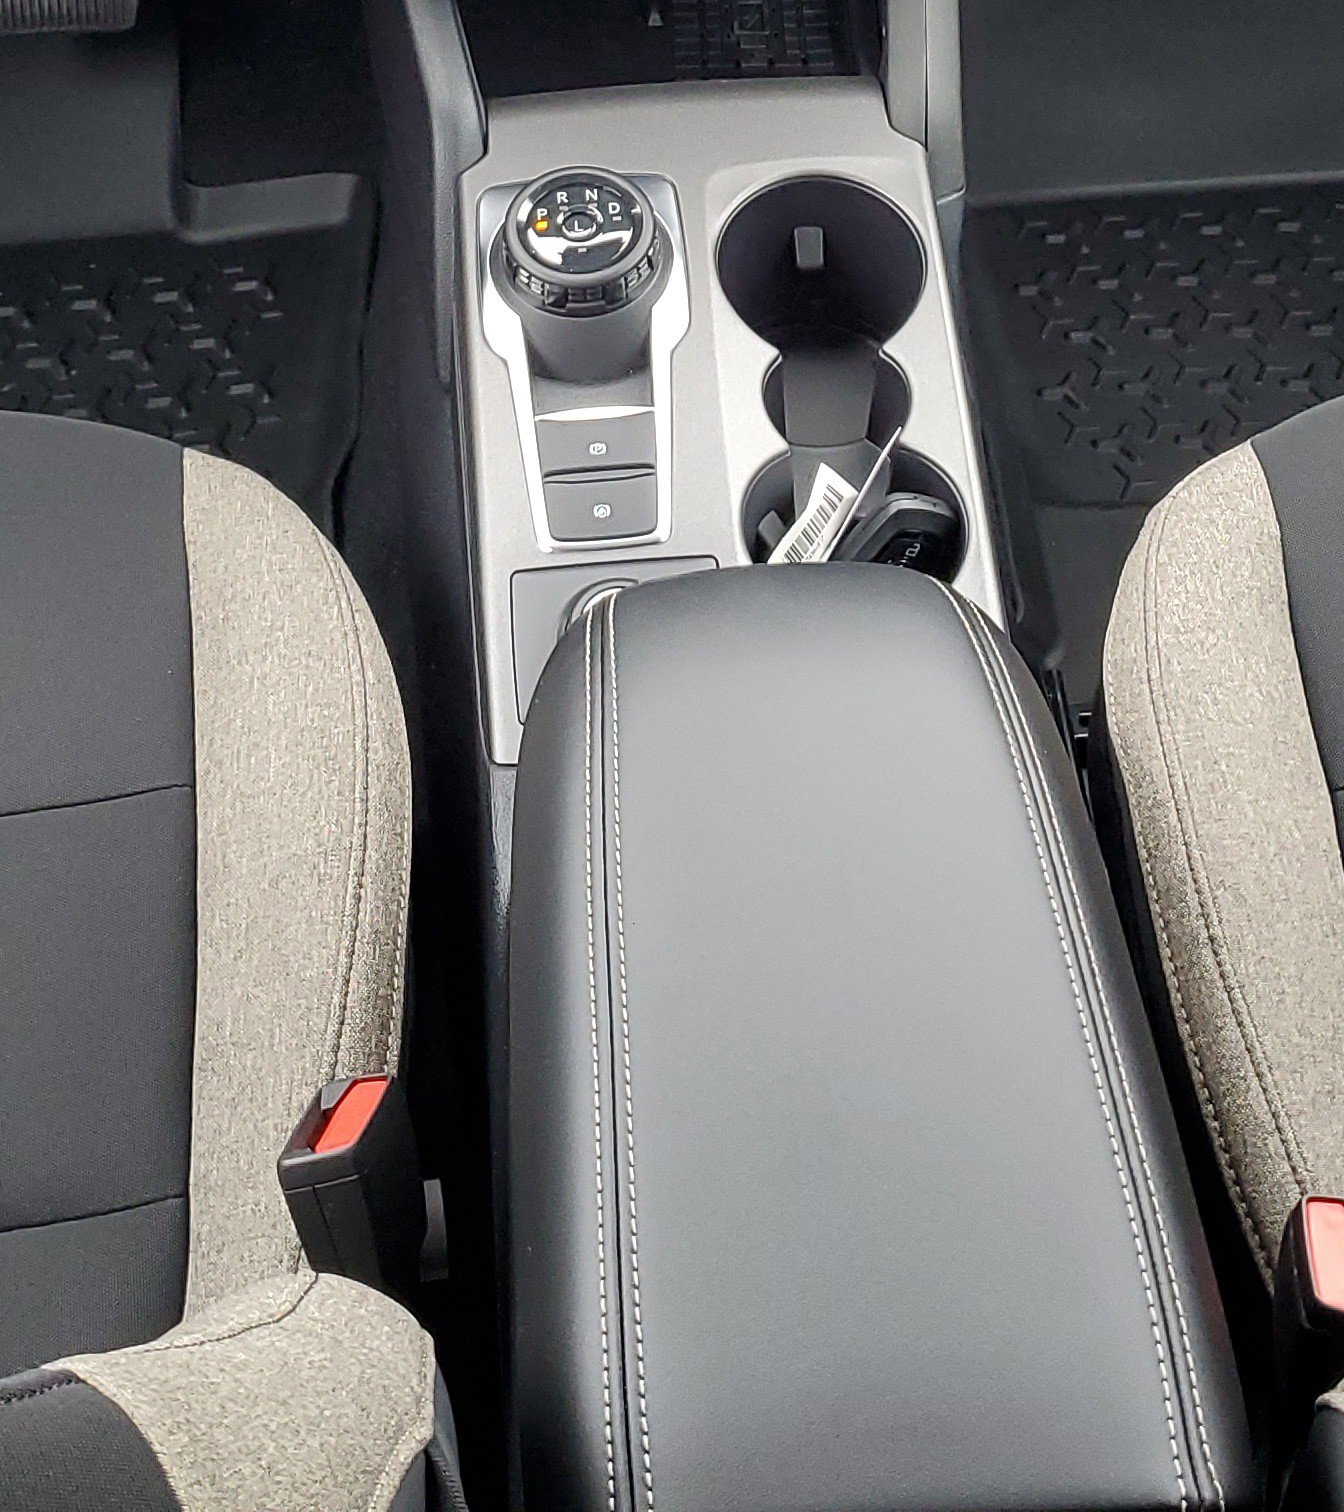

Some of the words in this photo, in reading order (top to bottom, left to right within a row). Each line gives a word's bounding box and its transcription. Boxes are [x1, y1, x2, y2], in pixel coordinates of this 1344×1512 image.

[556, 191, 568, 204] R
[585, 188, 598, 201] N
[536, 208, 548, 221] P
[608, 202, 621, 215] D
[574, 220, 584, 231] L
